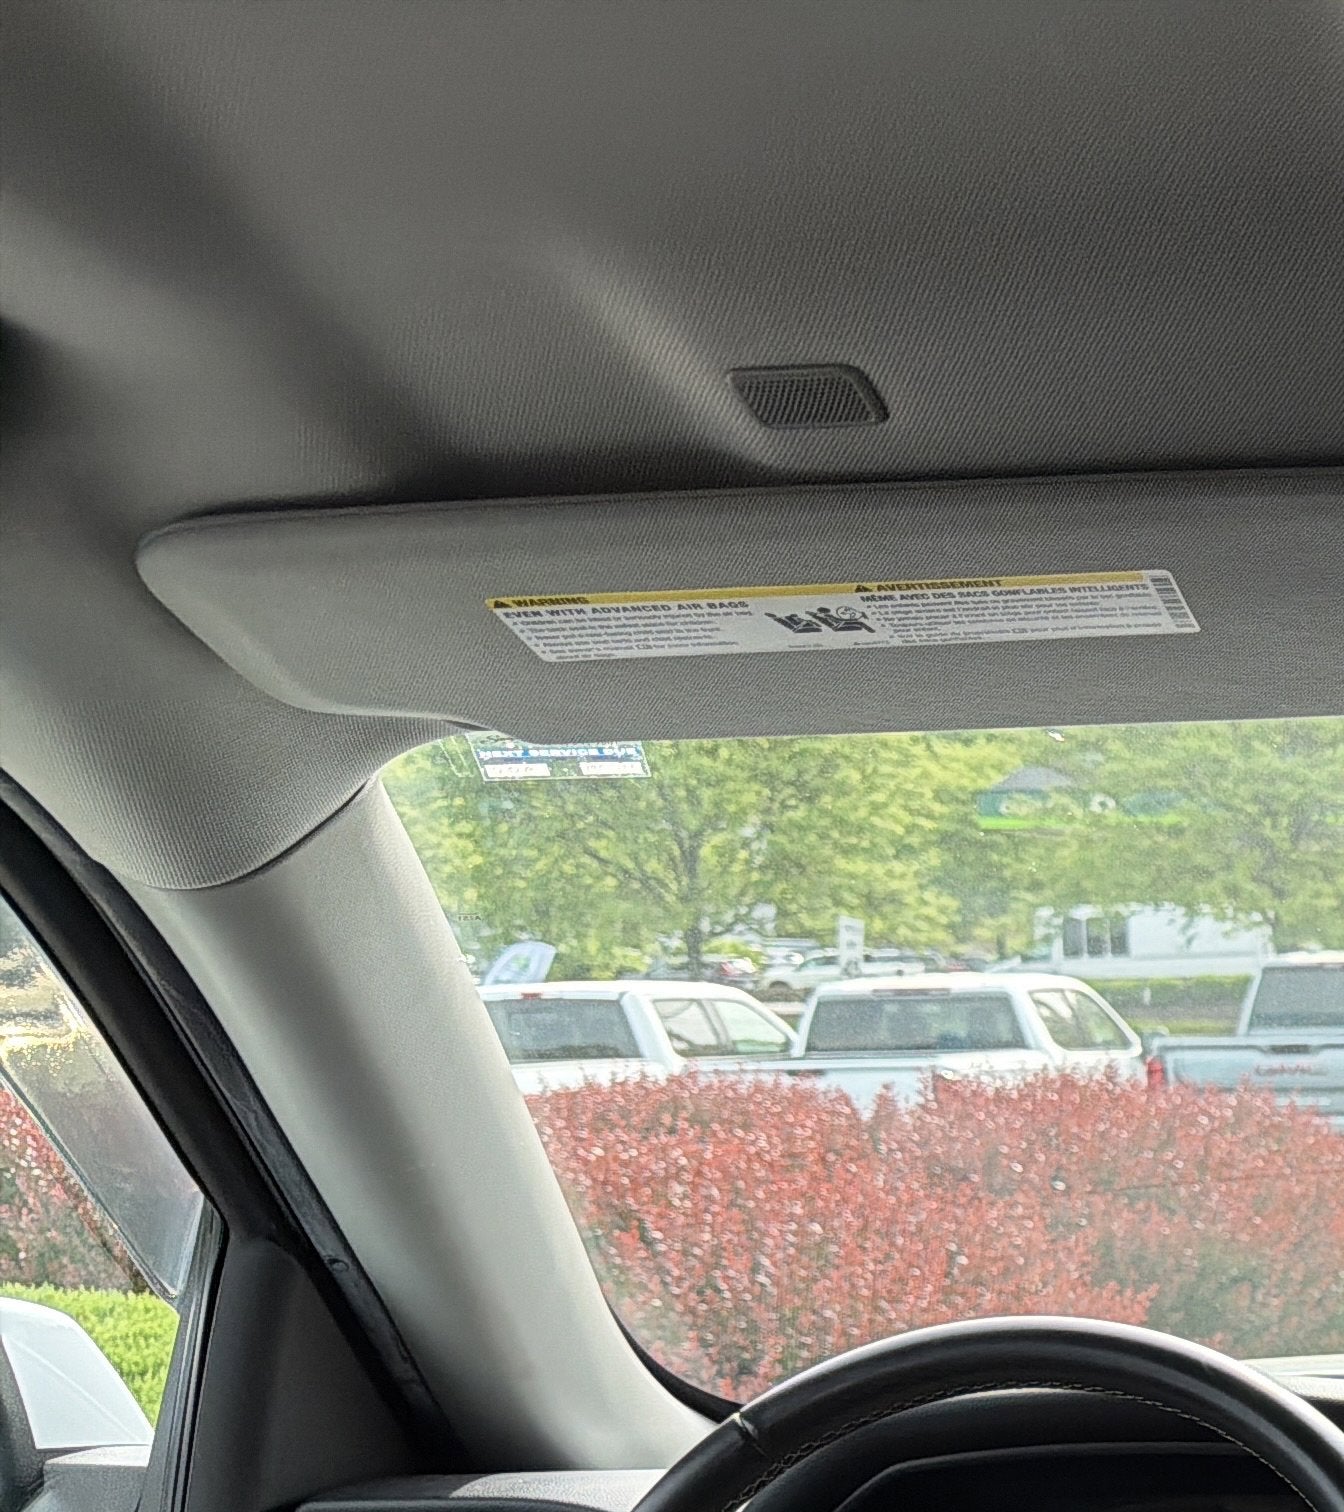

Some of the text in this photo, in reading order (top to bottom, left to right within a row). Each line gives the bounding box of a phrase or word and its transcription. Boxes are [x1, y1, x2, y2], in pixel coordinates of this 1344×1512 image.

[860, 583, 1150, 603] MÊME AVEC DES SACS GONFLABLES INTELLIGENTS
[876, 578, 1002, 593] AVERTISSEMENT
[504, 599, 750, 620] EVEN WITH ADVANCED AIR BAGS
[511, 596, 590, 608] WARNING
